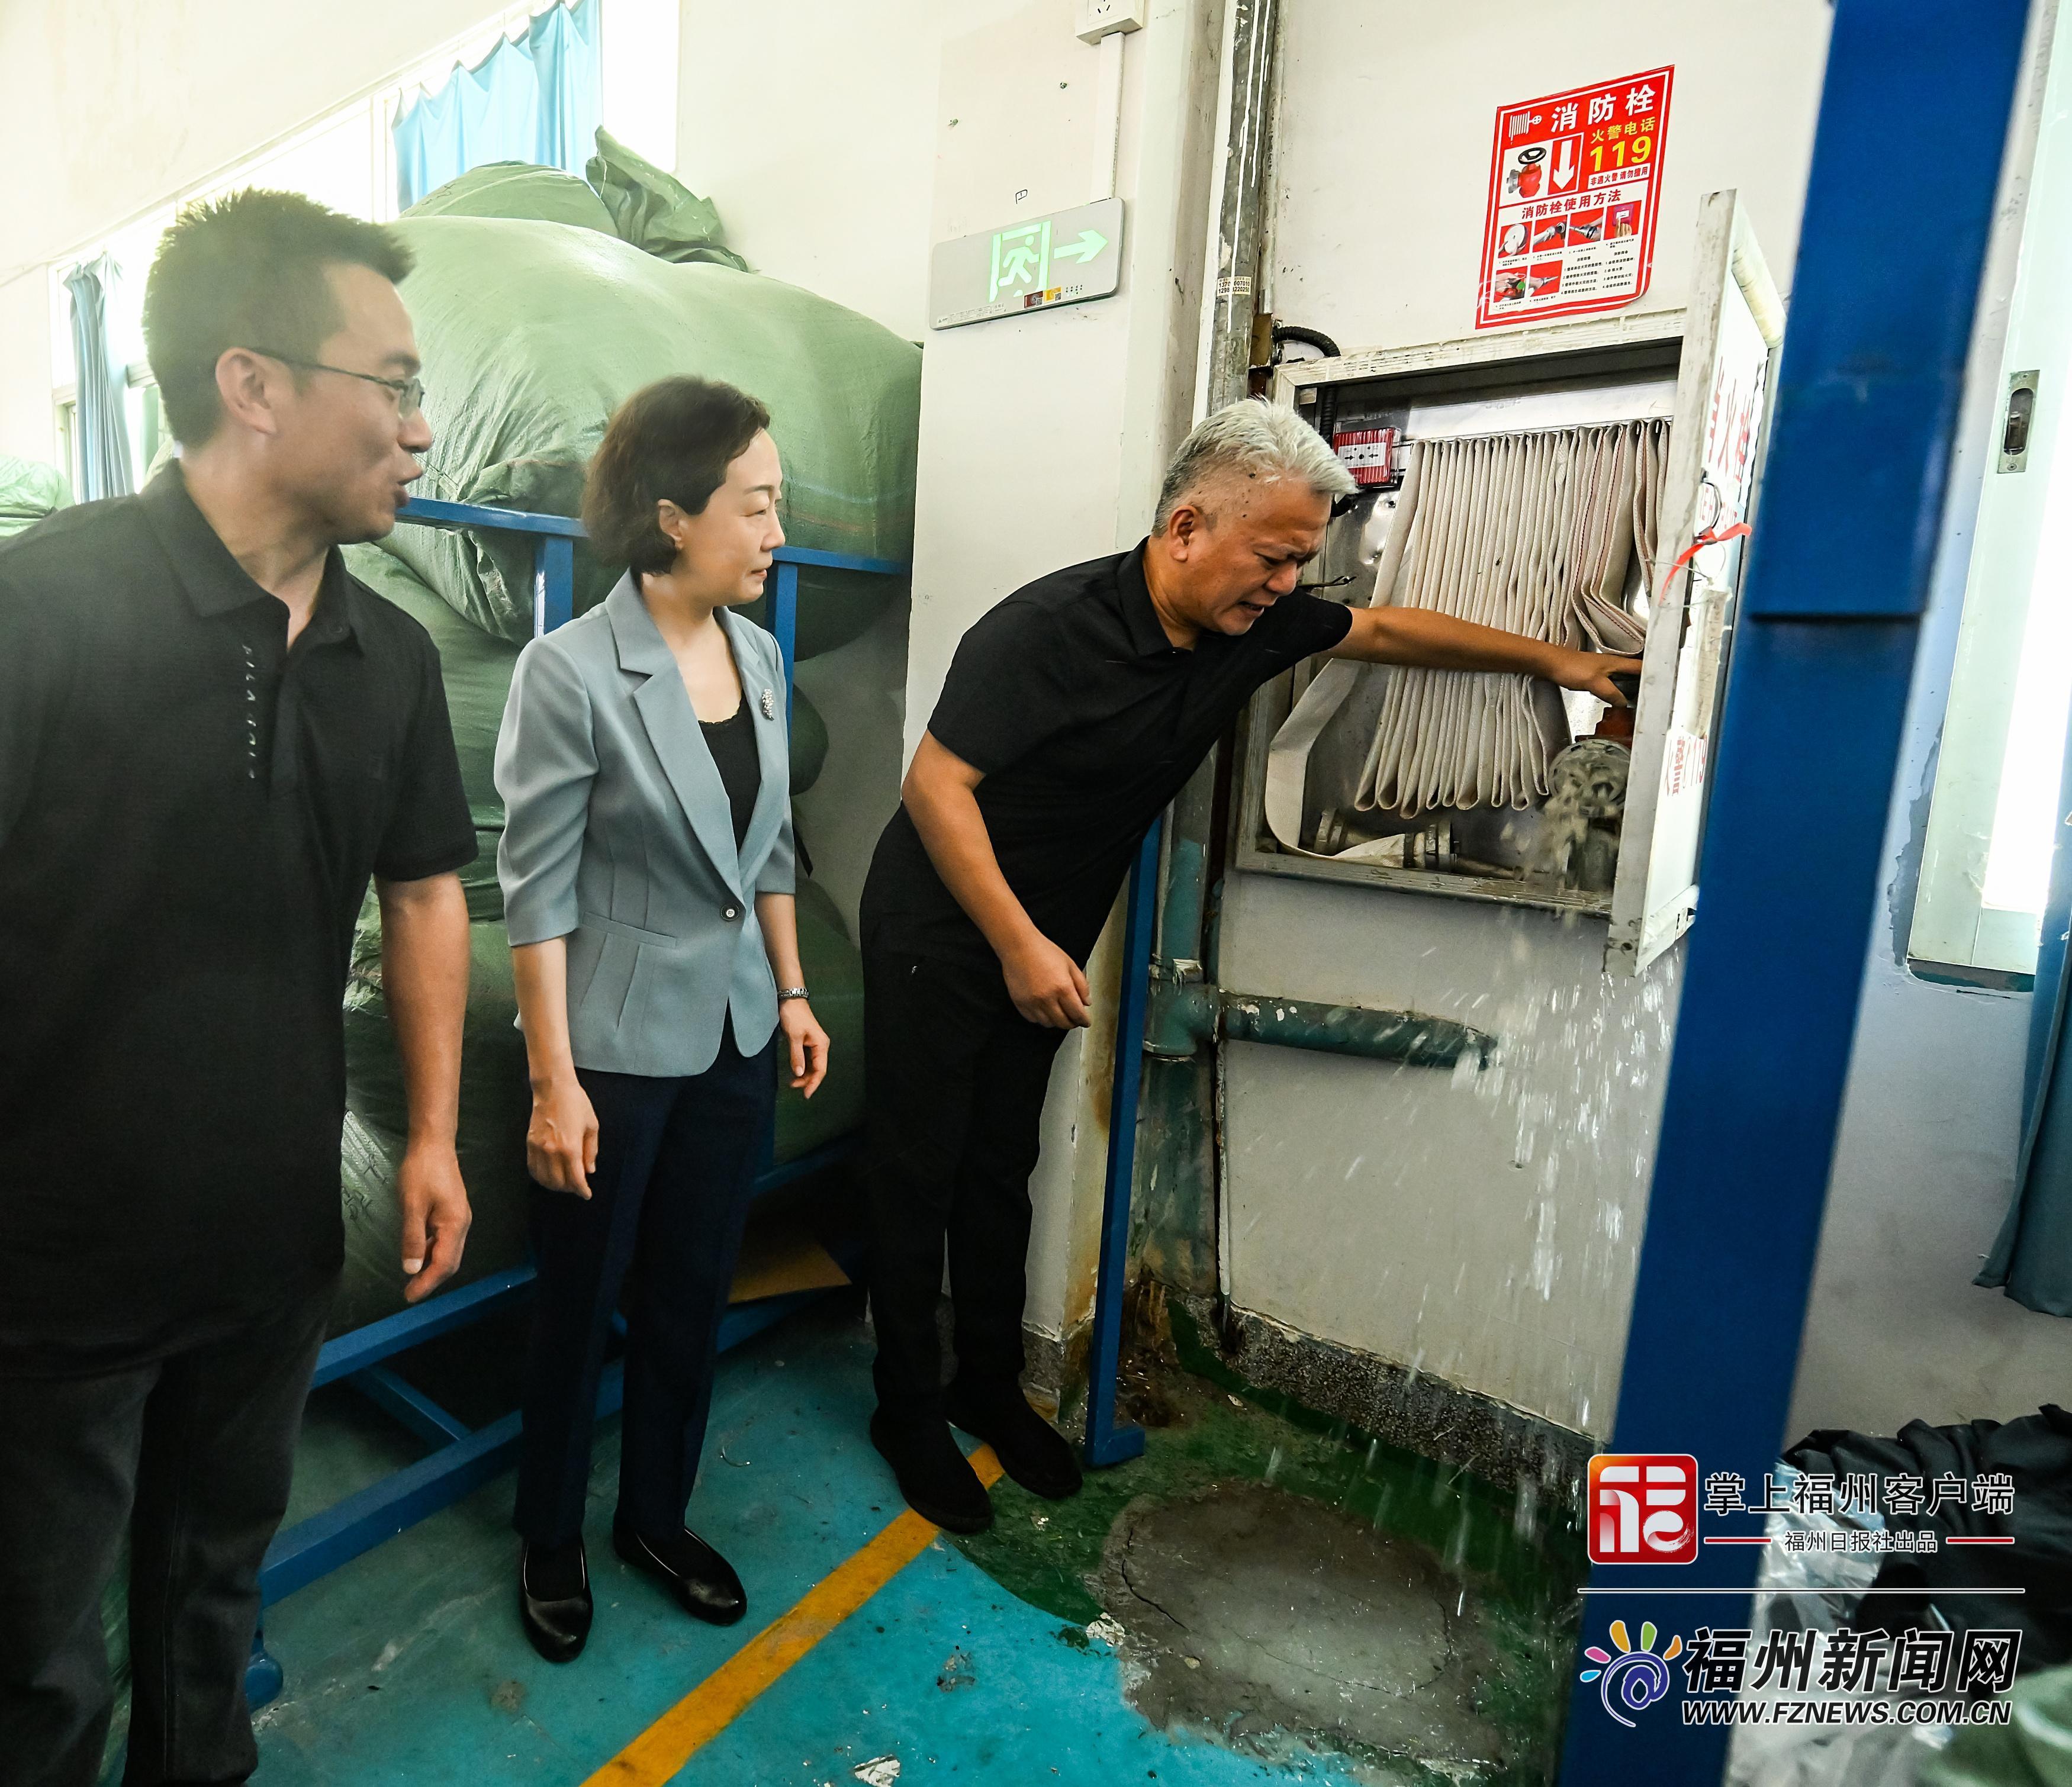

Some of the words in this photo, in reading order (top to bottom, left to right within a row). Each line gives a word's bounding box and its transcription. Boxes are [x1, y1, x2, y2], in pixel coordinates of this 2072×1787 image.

[1550, 83, 1656, 133] 消防栓
[1590, 116, 1656, 144] 火警电话
[1590, 136, 1652, 172] 119
[1521, 189, 1621, 220] 消防栓使用方法
